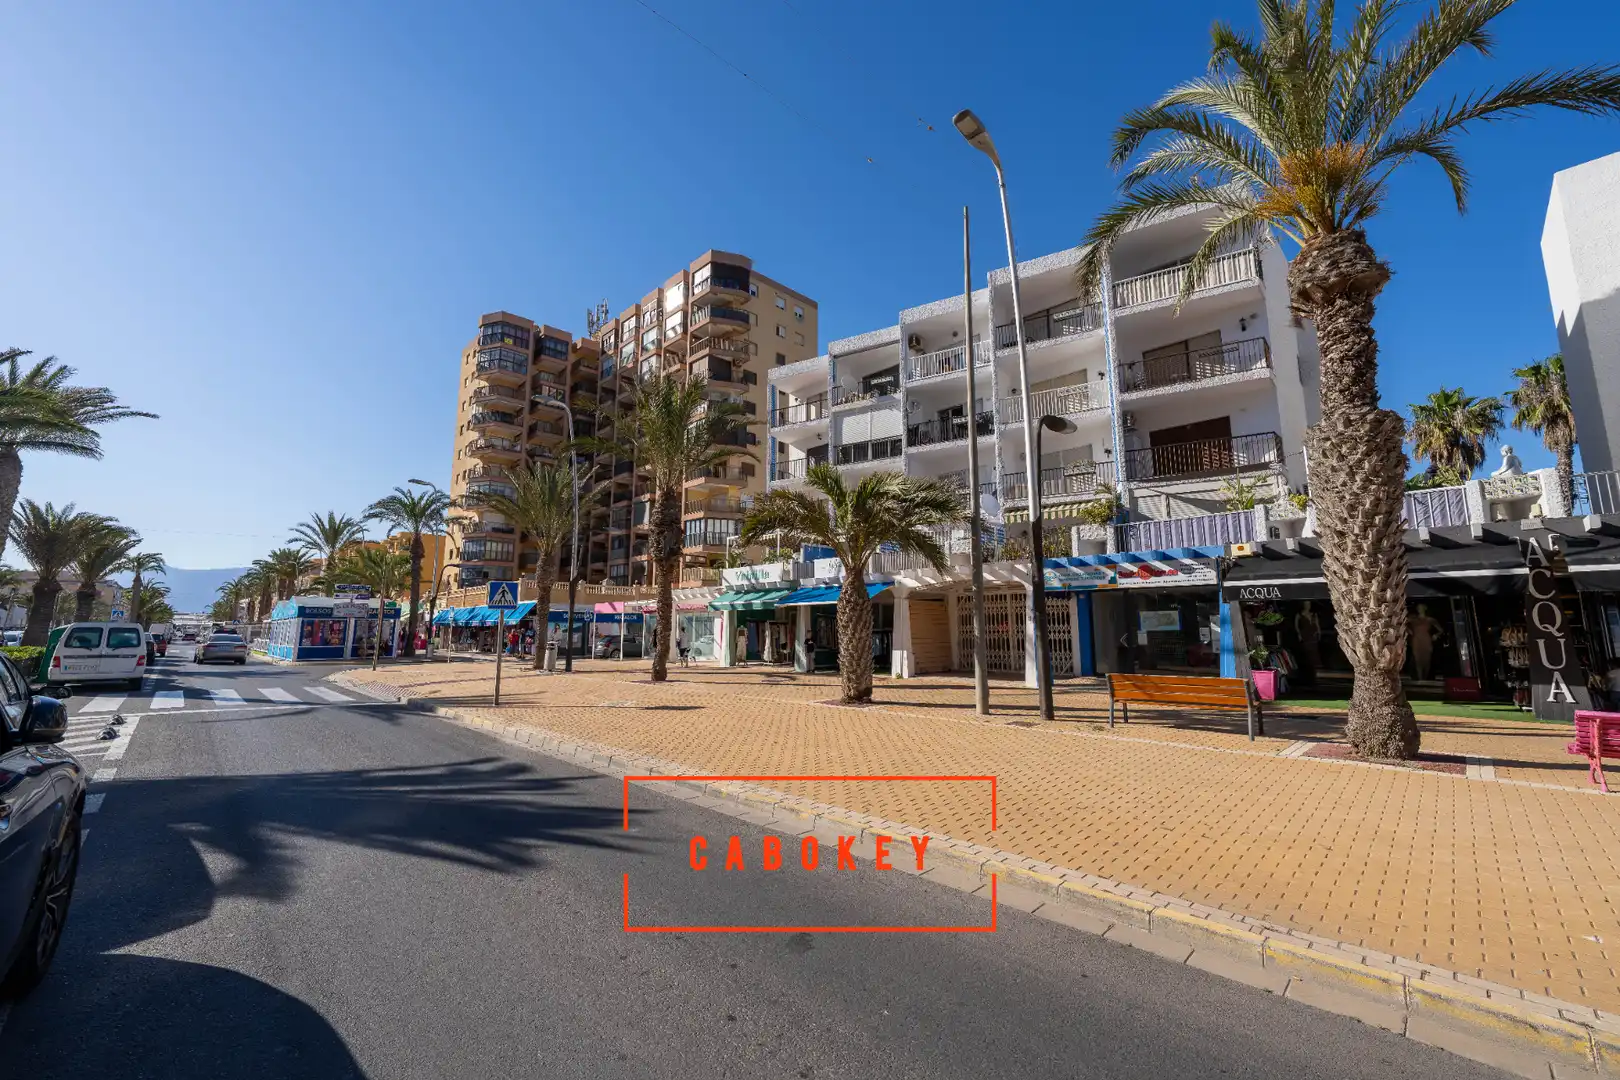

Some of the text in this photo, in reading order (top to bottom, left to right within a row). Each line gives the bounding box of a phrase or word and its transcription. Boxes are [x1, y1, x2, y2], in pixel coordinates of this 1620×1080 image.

[1240, 587, 1281, 599] ACQUA
[305, 607, 332, 615] BOLSOS
[1526, 537, 1576, 703] ACQUA
